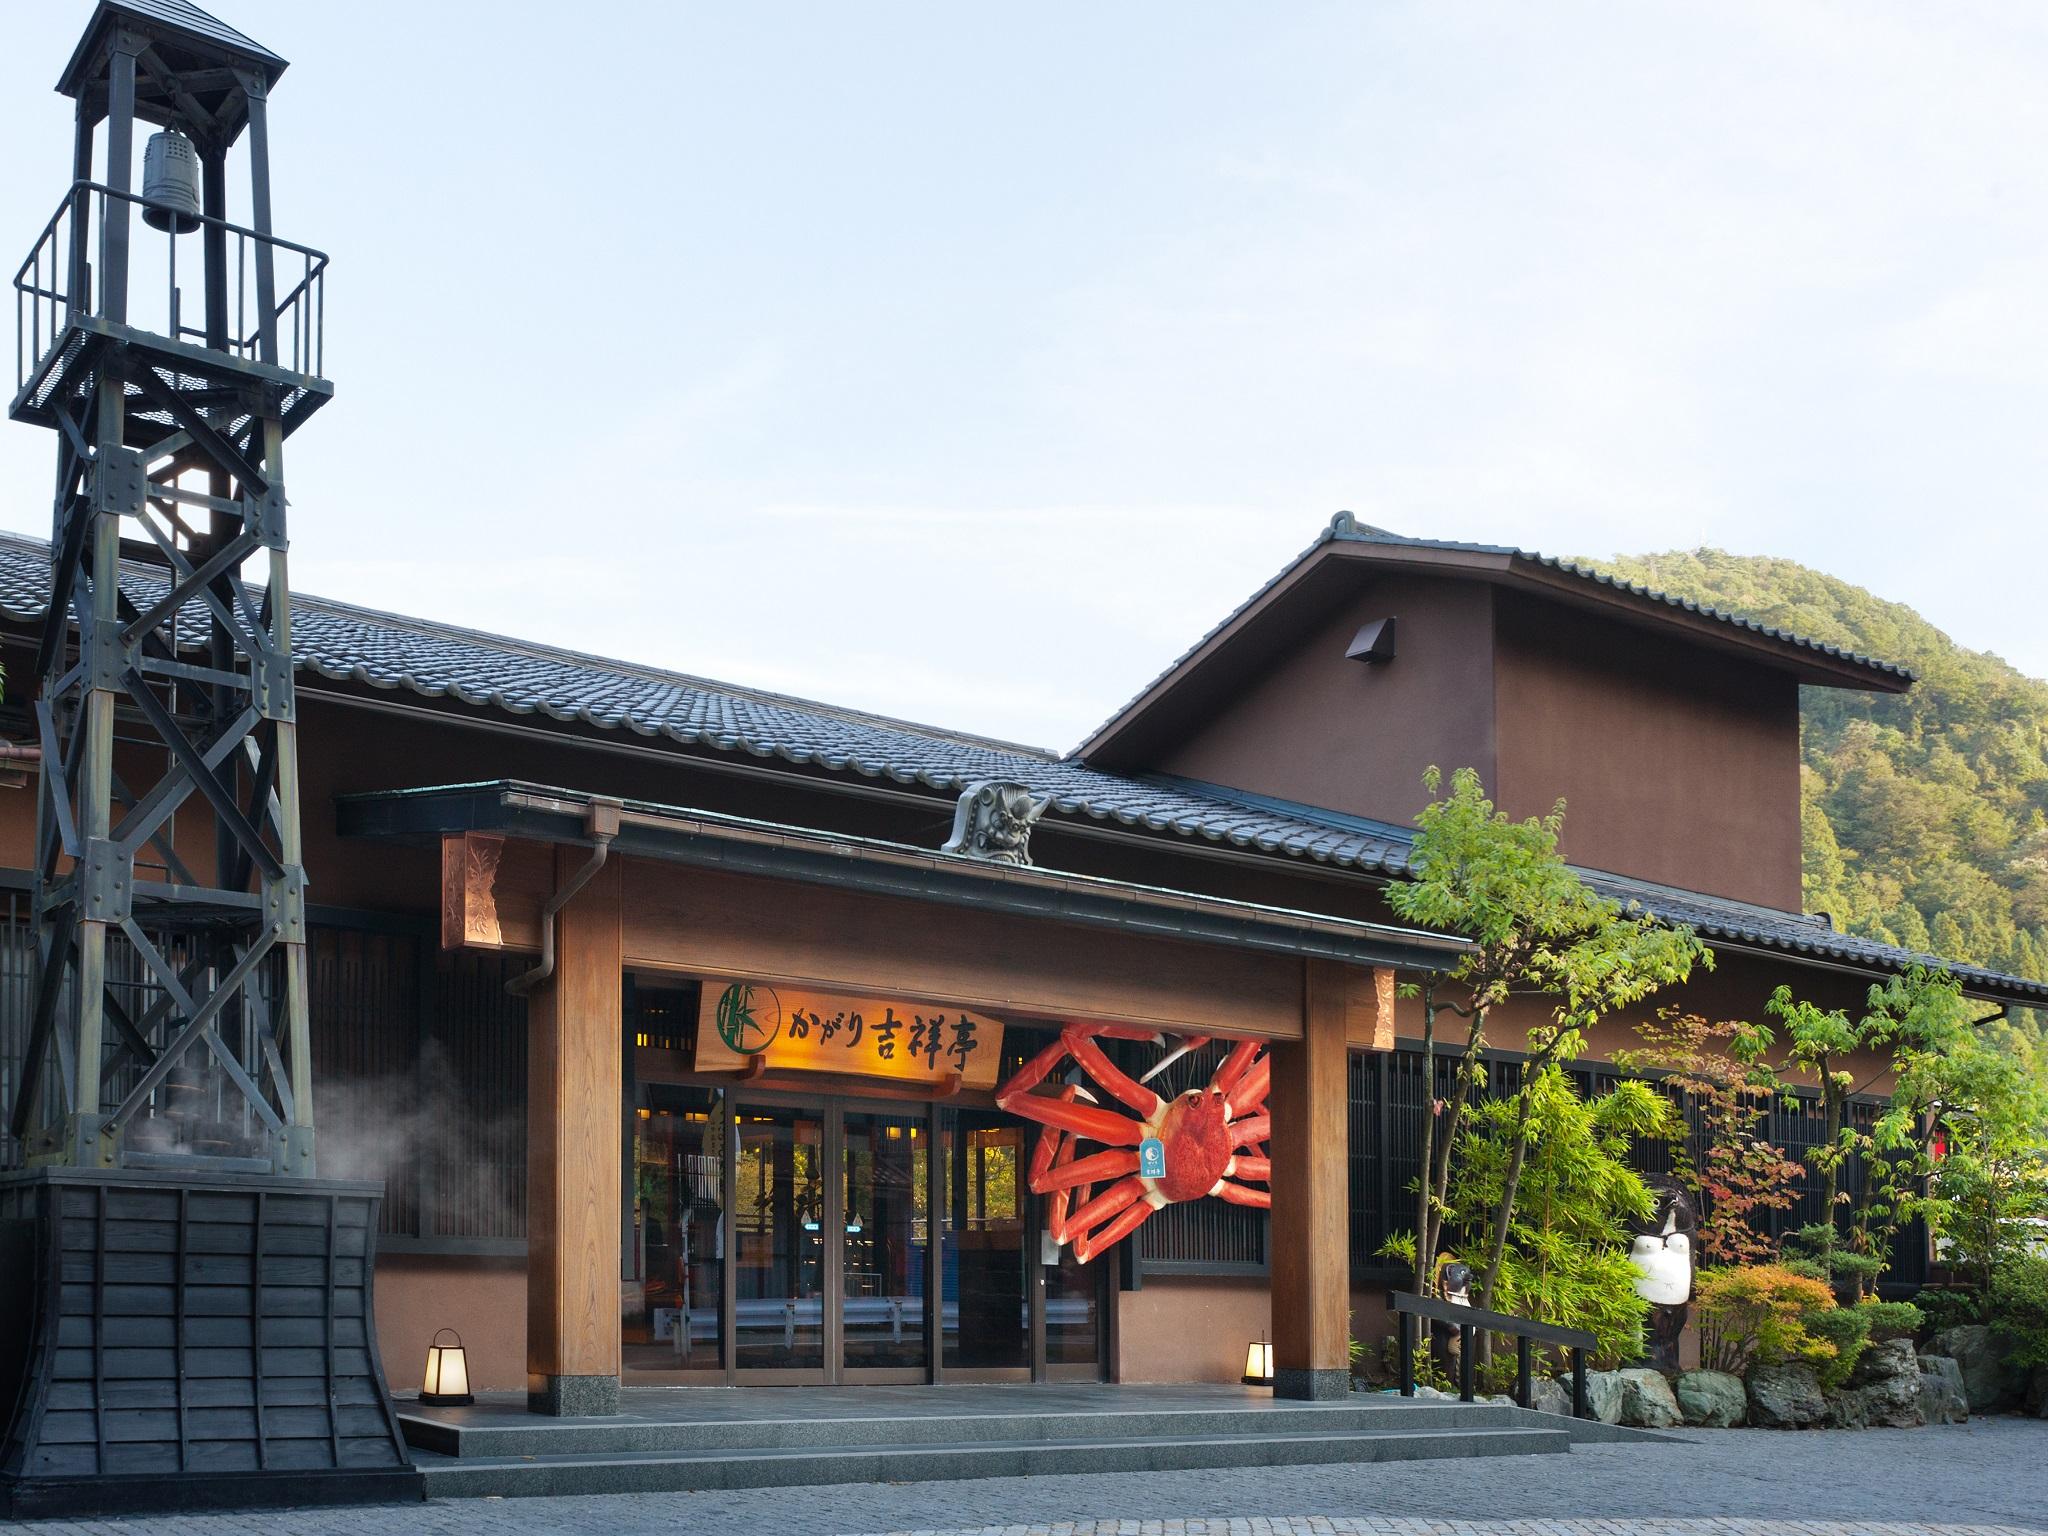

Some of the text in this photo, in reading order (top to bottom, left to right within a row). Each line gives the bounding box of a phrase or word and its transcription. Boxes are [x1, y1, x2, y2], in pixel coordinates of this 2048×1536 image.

[788, 1007, 978, 1072] かがり吉祥亭
